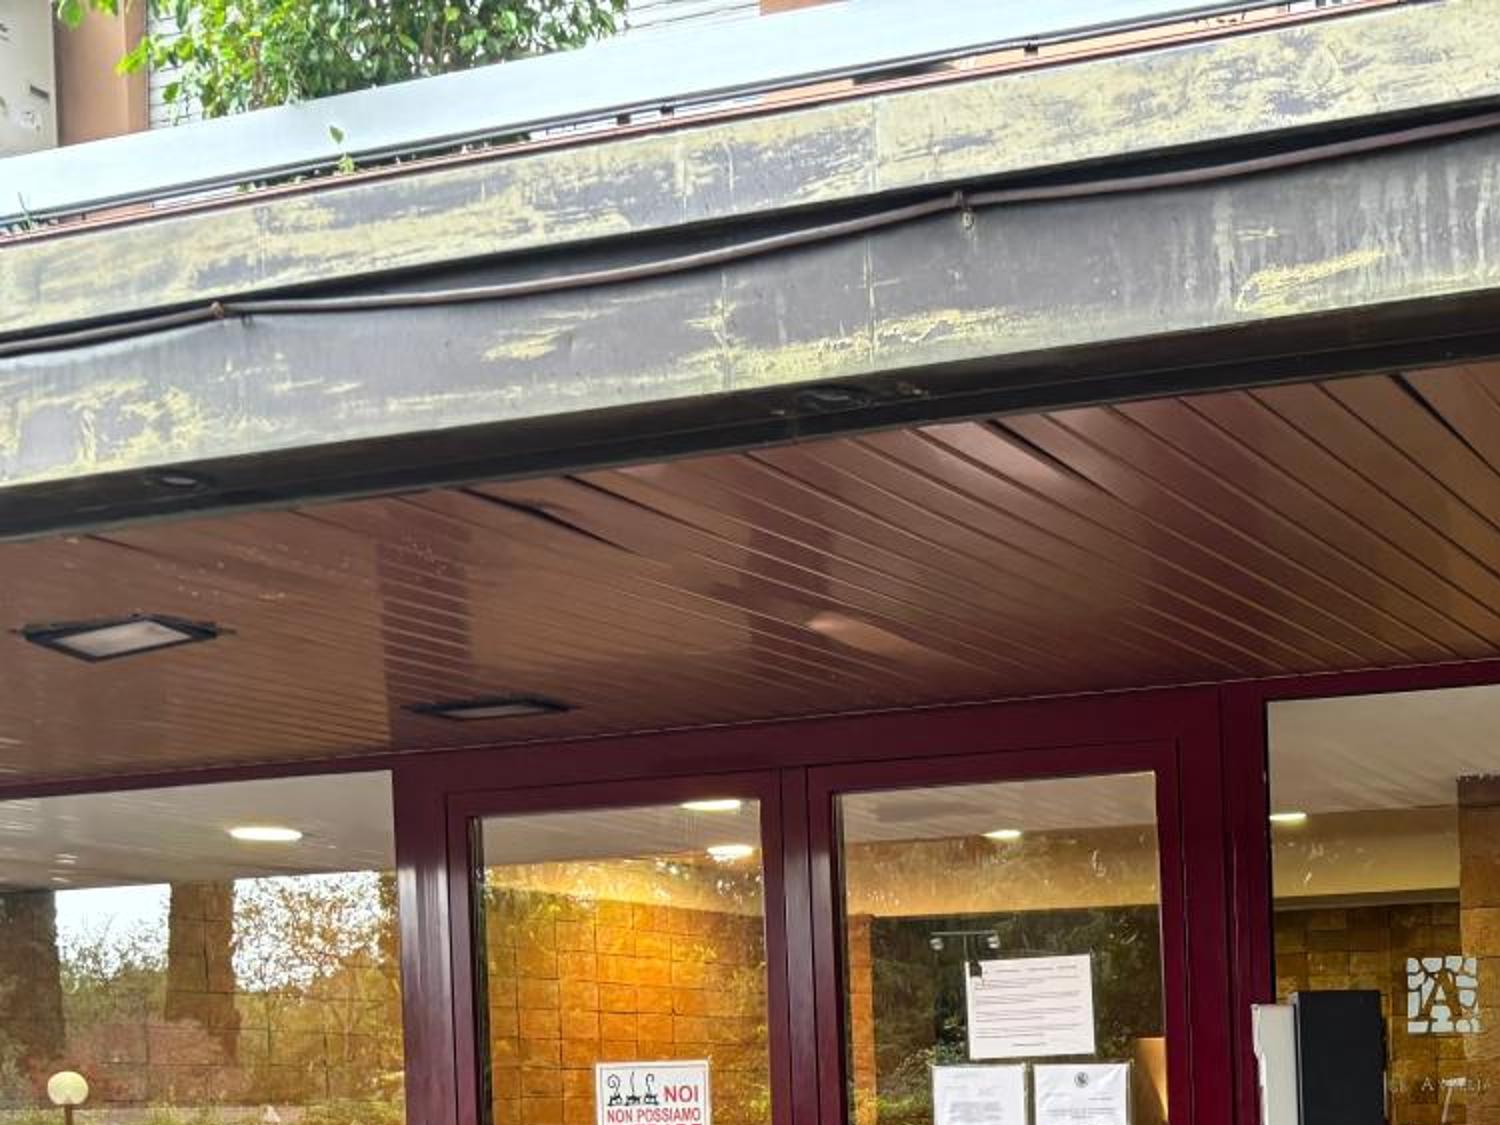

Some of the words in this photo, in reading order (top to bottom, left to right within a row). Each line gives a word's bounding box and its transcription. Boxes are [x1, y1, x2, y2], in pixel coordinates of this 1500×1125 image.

[1420, 1075, 1491, 1092] AVLIA
[663, 1084, 699, 1103] NOI
[606, 1107, 633, 1123] NON
[636, 1106, 702, 1122] POSSIAMO
